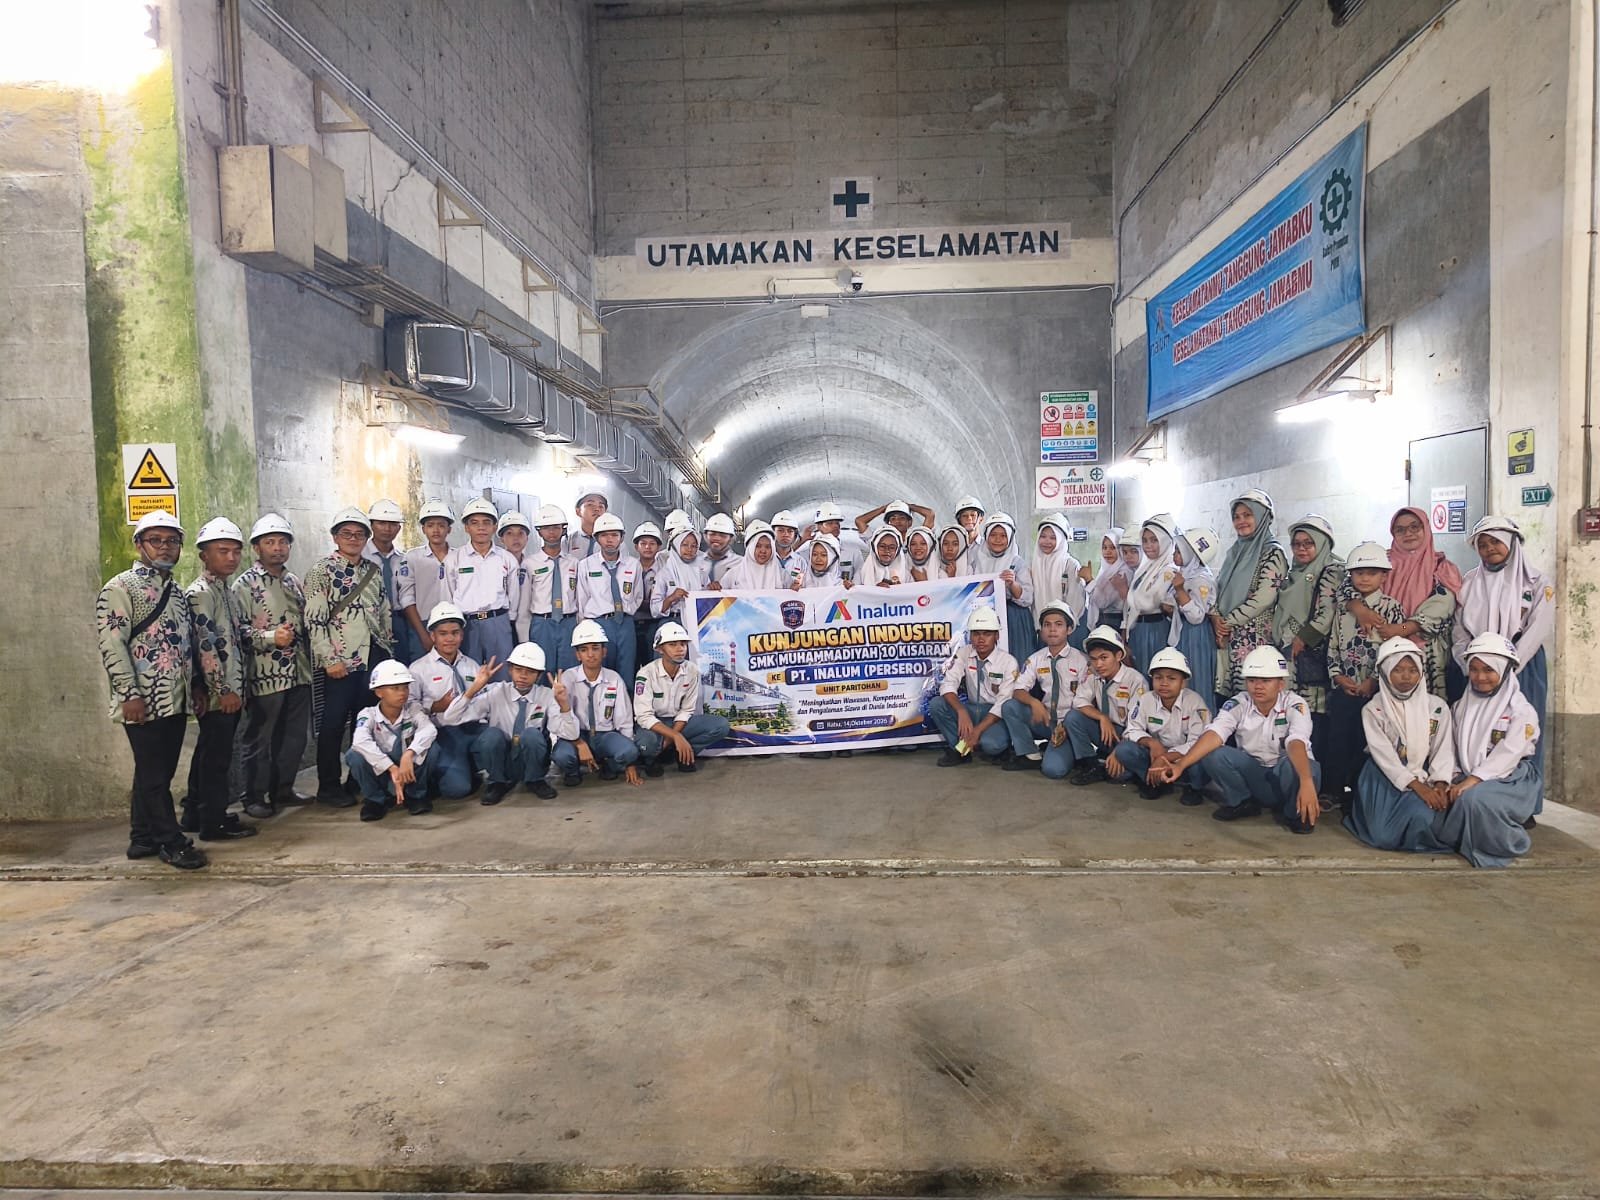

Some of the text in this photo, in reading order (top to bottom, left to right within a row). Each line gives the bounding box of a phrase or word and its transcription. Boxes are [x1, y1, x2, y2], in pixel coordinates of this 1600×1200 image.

[648, 230, 1059, 267] UTAMAKAN KESELAMATAN
[1223, 238, 1267, 291] TANGGUNG
[1267, 201, 1313, 261] JAWABKU
[1223, 289, 1267, 335] TANGGUNG
[1267, 259, 1313, 311] JAWABMU
[1064, 484, 1105, 494] DILARANG
[1524, 489, 1547, 502] EXIT
[1064, 495, 1105, 505] MEROKOK
[857, 603, 914, 619] Inalum
[750, 622, 951, 653] KUNJUNGAN INDUSTRI
[750, 643, 951, 669] SMK MUHAMMADIYAH 10 KISARAN
[772, 663, 927, 682] KE PT. INALUM (PERSERO)
[841, 683, 881, 691] PARITOHAN
